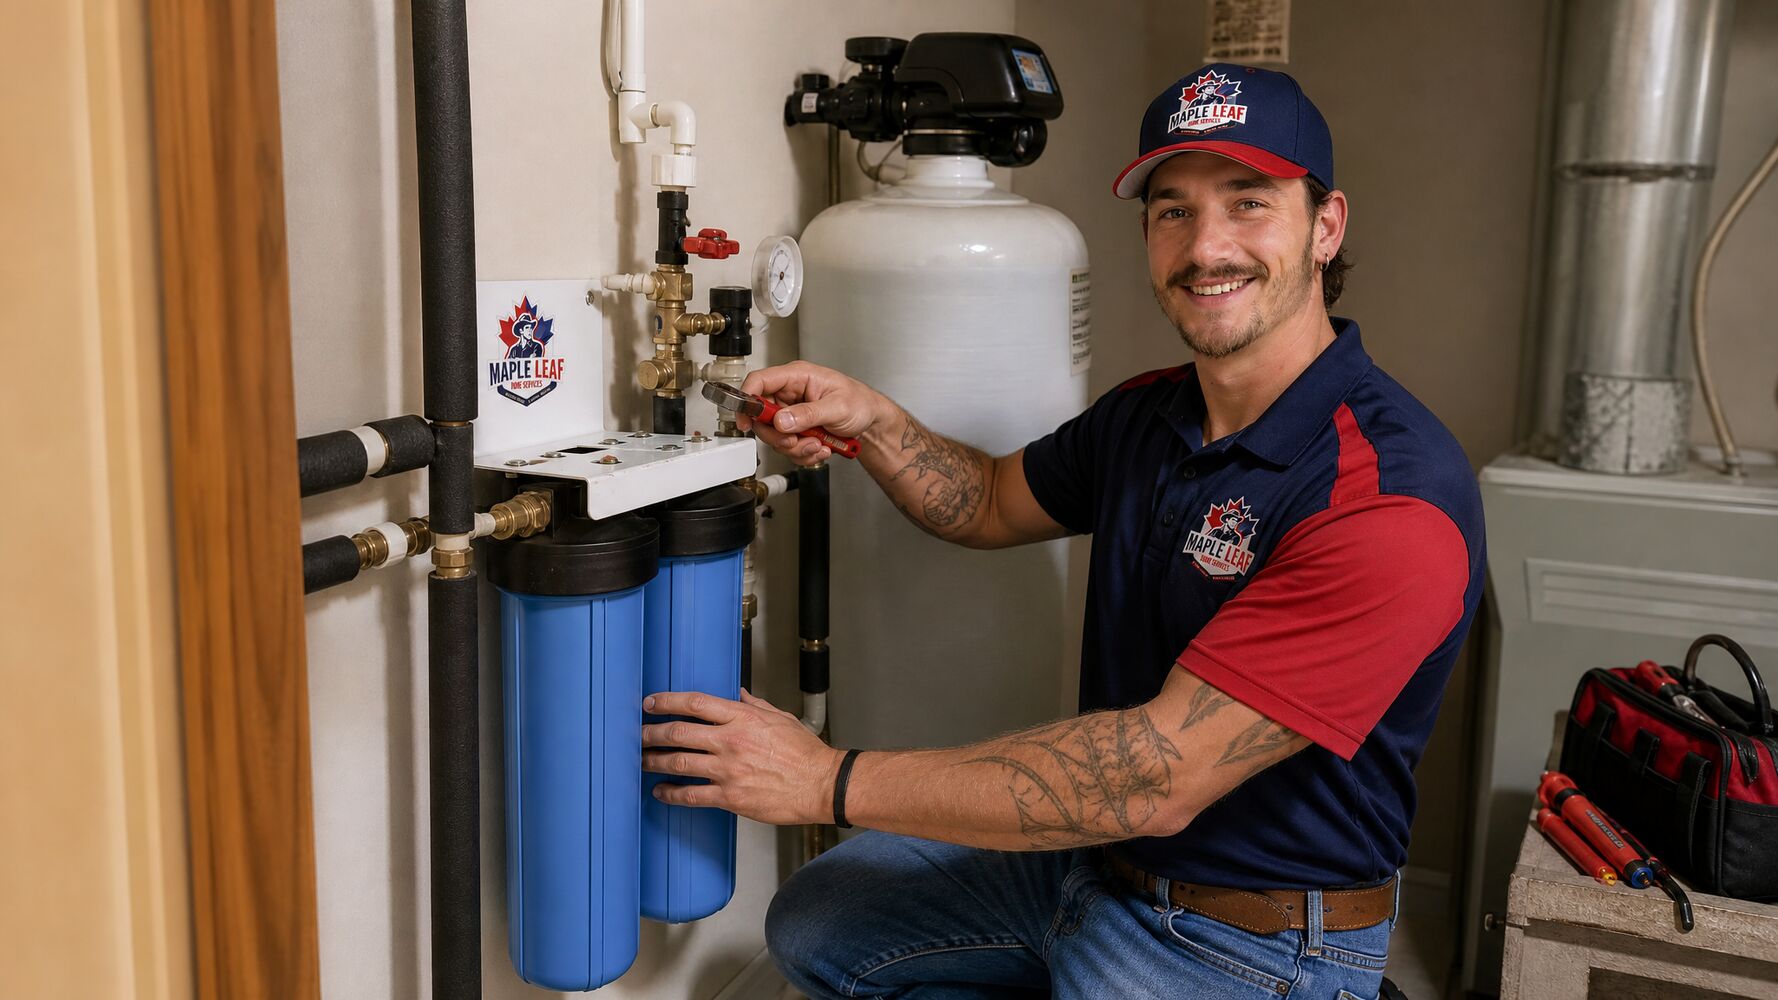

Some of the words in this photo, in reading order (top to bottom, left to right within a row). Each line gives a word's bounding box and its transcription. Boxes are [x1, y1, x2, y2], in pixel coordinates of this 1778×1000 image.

[1169, 106, 1210, 130] MAPLE
[1212, 105, 1245, 121] LEAF
[489, 360, 532, 386] MAPLE
[535, 358, 565, 380] LEAF
[1185, 533, 1226, 559] MAPLE
[1224, 545, 1252, 574] LEAF
